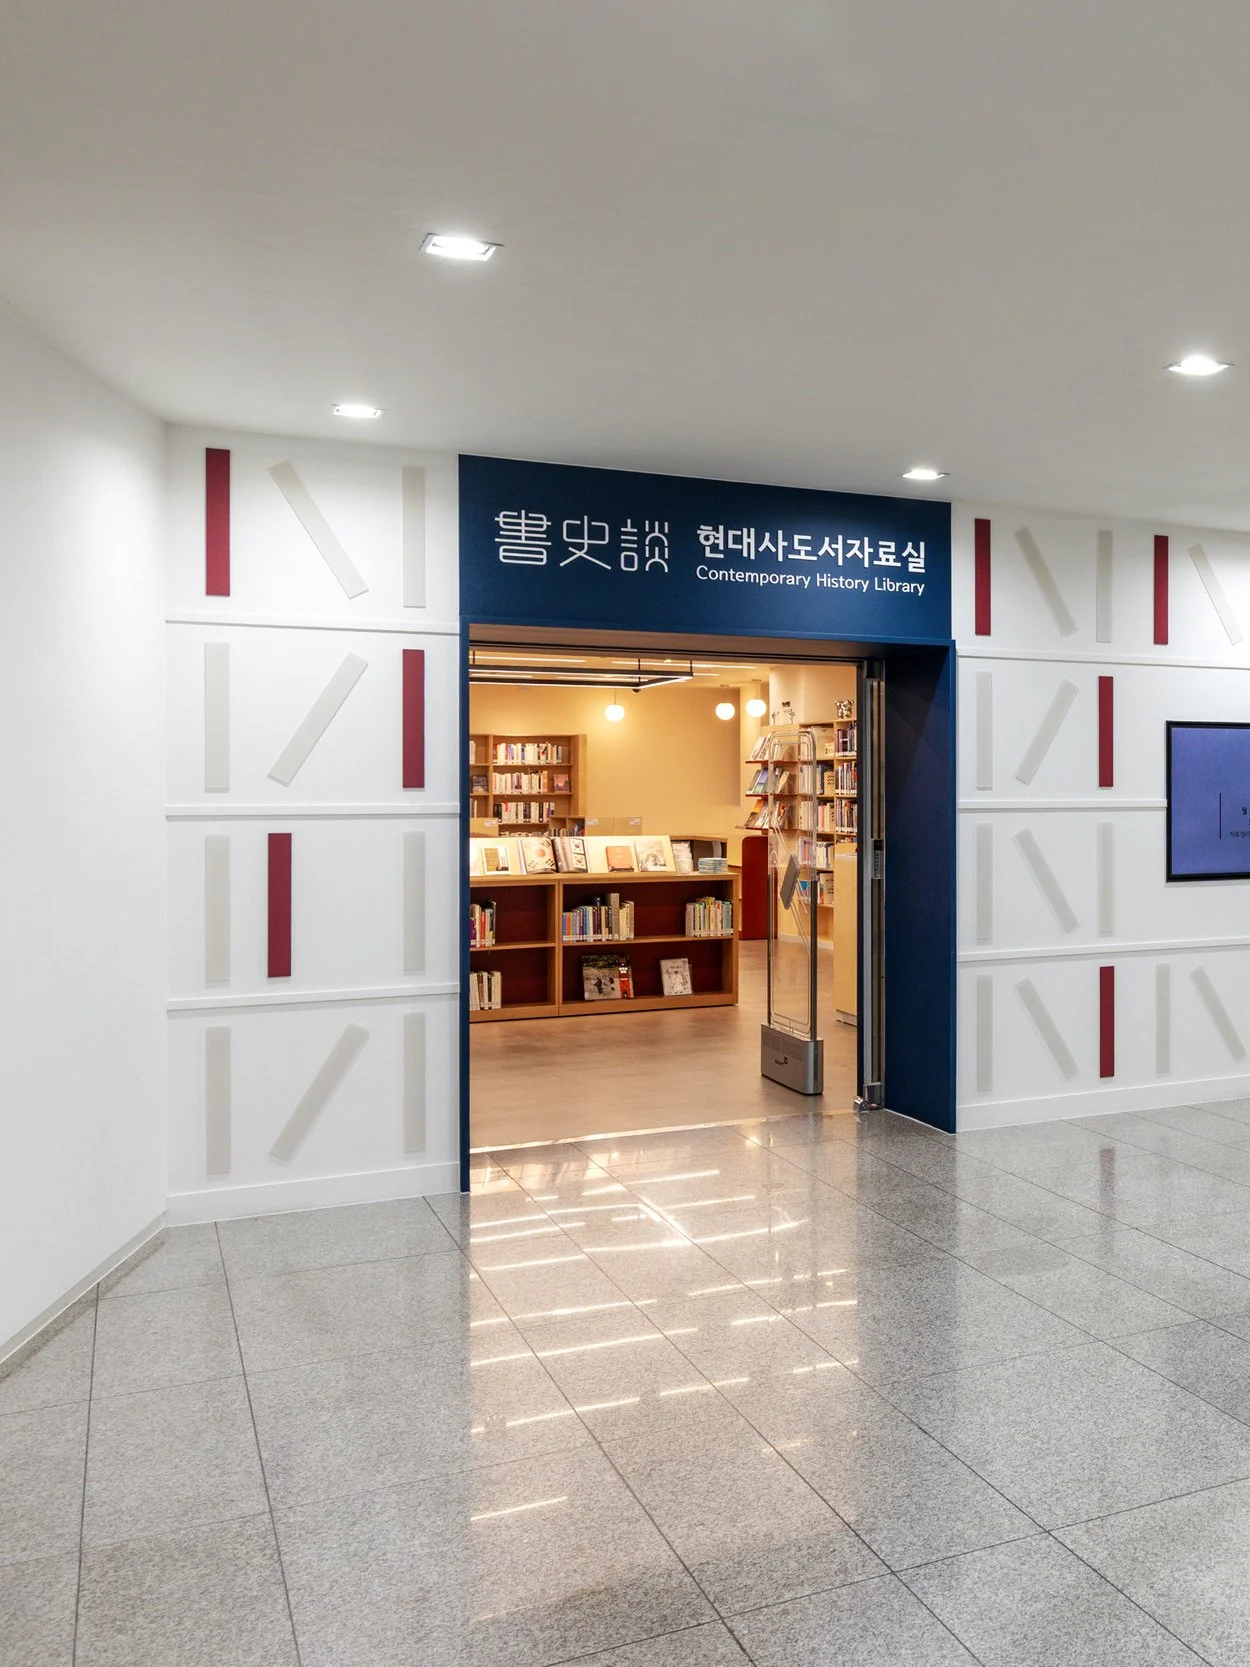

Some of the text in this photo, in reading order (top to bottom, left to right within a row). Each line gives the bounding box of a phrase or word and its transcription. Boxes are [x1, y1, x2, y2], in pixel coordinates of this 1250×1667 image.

[494, 509, 669, 574] 書史談
[697, 524, 927, 573] 현대사도서자료실
[696, 565, 926, 596] Contemporary History Library
